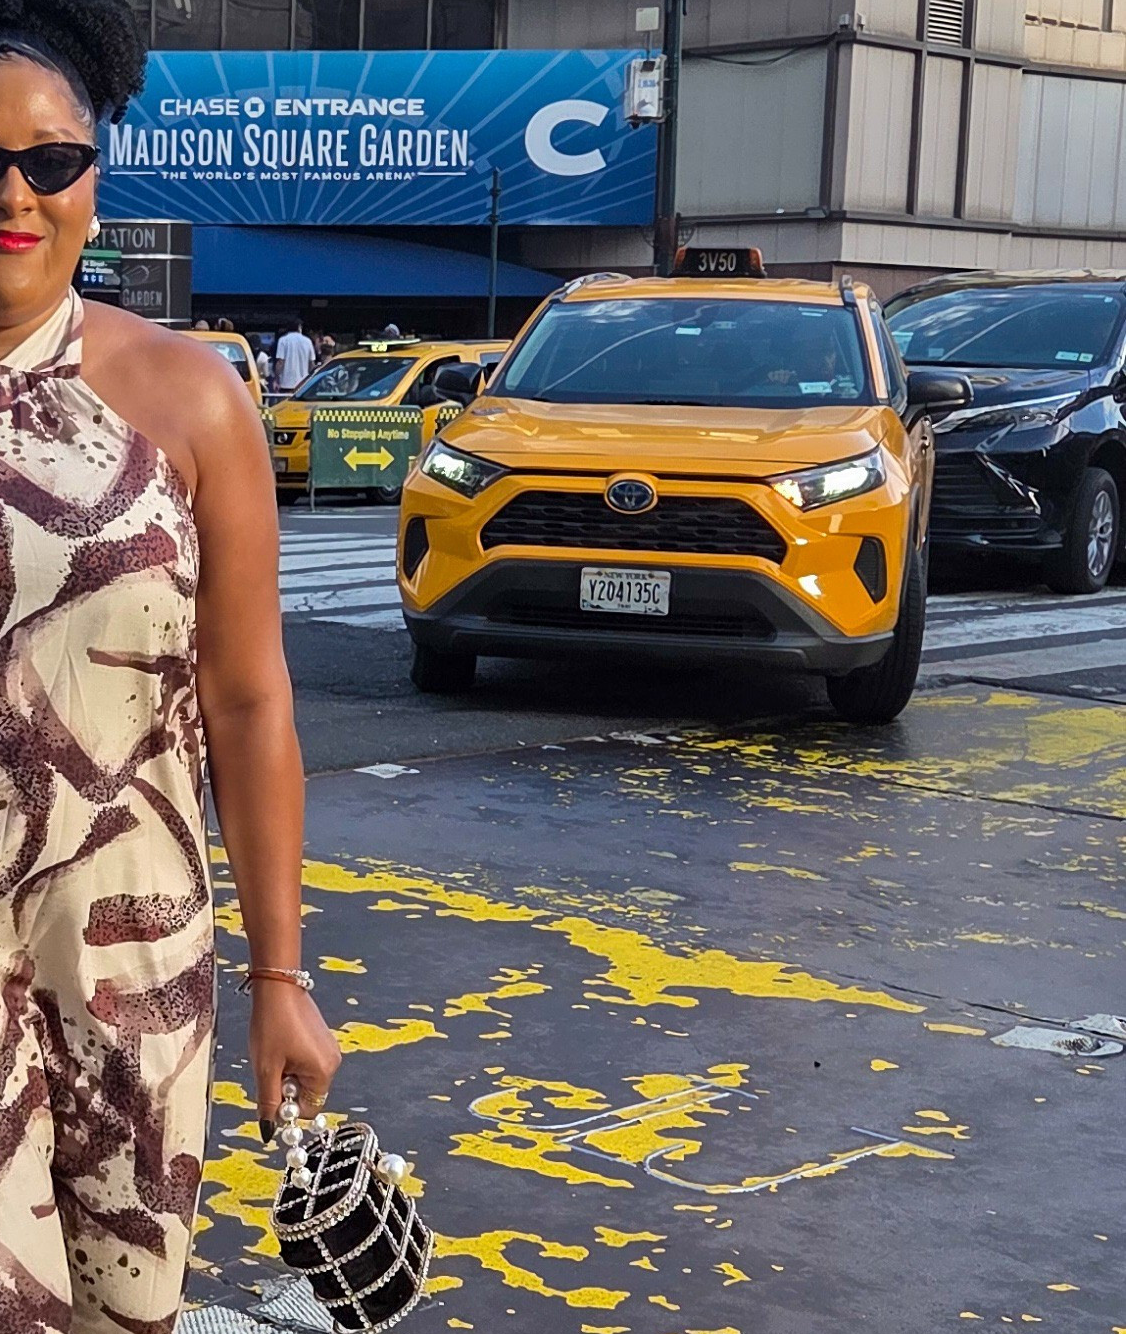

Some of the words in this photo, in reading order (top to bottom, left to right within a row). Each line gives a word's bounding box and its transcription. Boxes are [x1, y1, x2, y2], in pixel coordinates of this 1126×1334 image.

[160, 98, 241, 116] CHASE
[275, 98, 425, 116] ENTRANCE
[109, 123, 233, 167] MADISON
[243, 123, 350, 169] SQUARE
[524, 98, 610, 177] C
[161, 171, 187, 180] THE
[193, 171, 256, 181] WORLD'S
[260, 171, 298, 181] MOST
[305, 172, 361, 181] FAMOUS
[698, 251, 737, 272] 3V50
[122, 288, 163, 307] GARDEN
[327, 428, 340, 439] No
[341, 428, 376, 441] Stopping
[377, 428, 410, 442] Anytime
[589, 579, 661, 605] Y204135C
